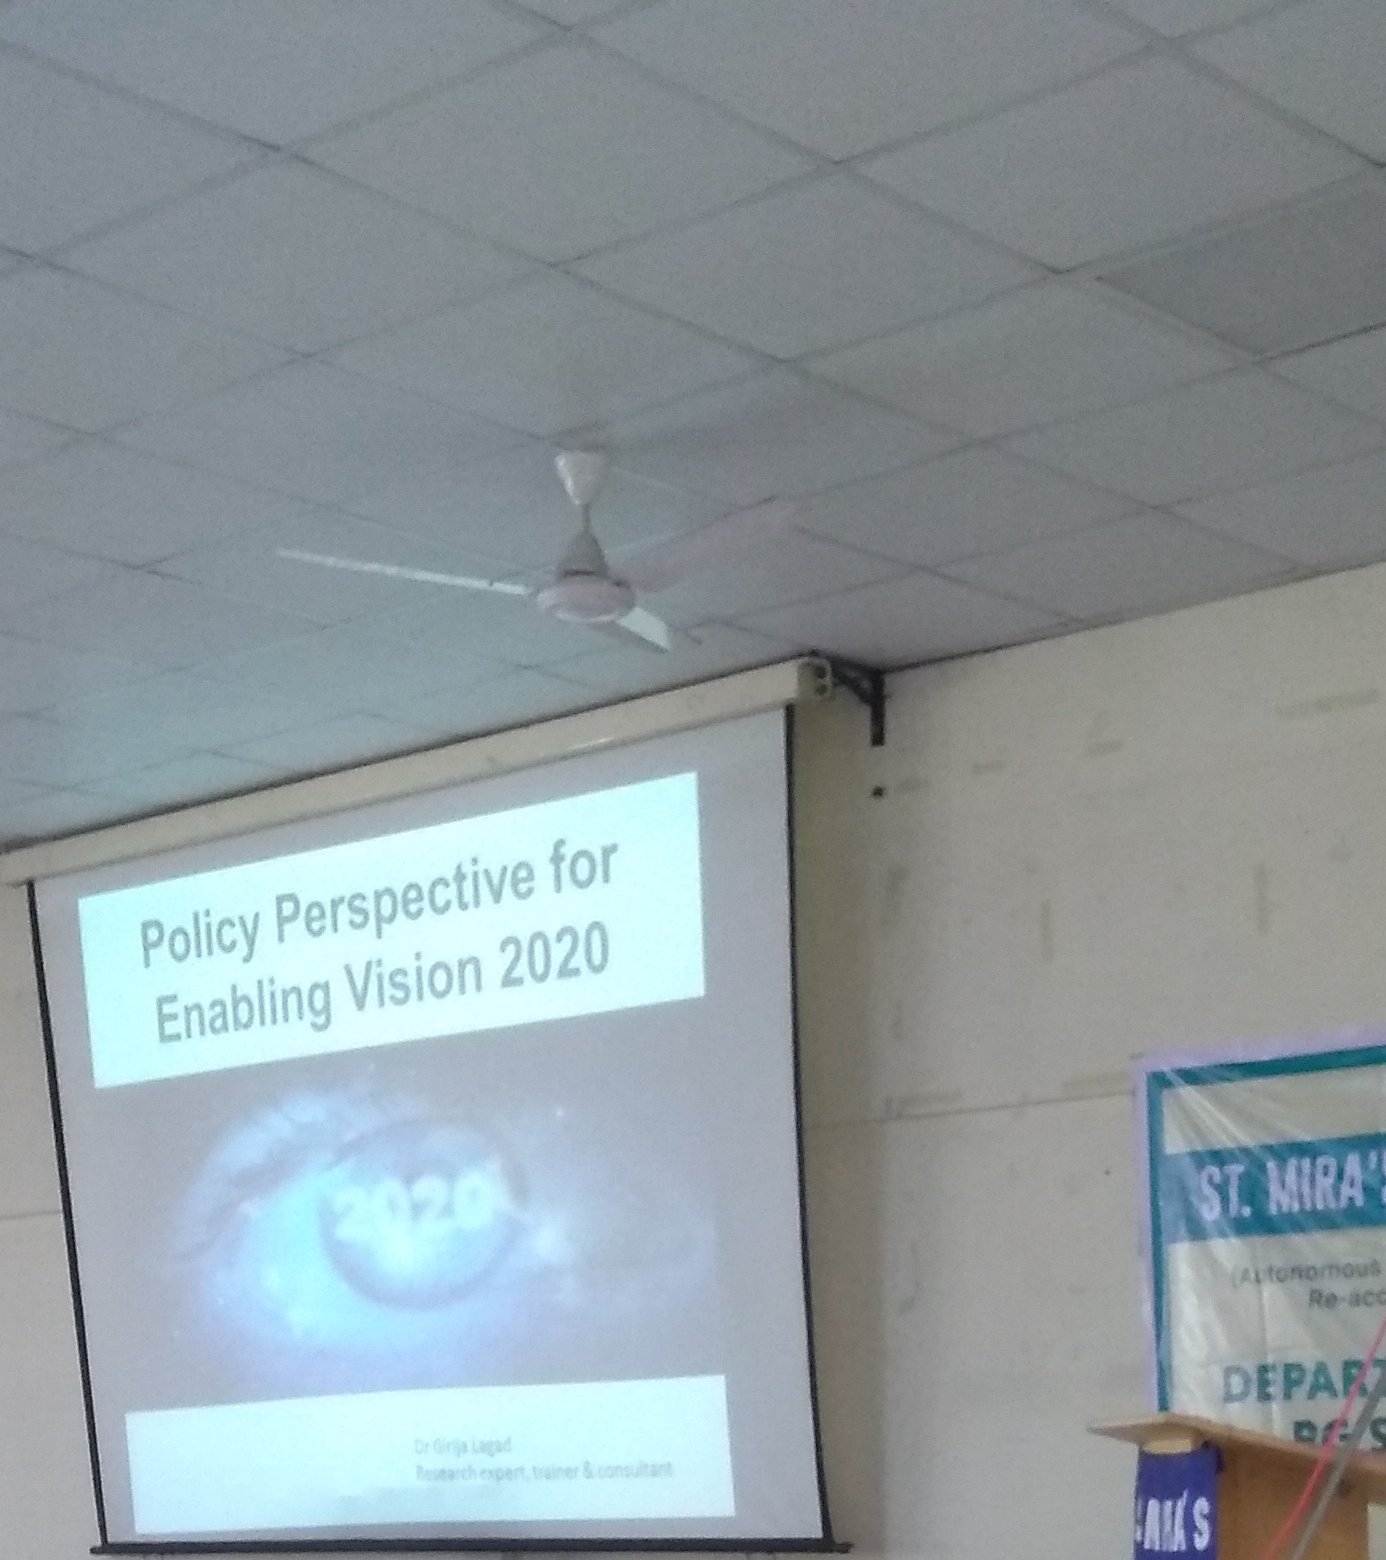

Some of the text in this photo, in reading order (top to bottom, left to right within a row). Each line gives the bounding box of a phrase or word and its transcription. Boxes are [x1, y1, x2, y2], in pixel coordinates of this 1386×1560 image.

[140, 838, 618, 968] Policy Perspective for
[155, 920, 611, 1044] Enabling Vision 2020
[332, 1174, 494, 1241] 2020
[1199, 1164, 1252, 1221] ST.
[416, 1464, 477, 1481] Research
[532, 1464, 580, 1479] trainer
[583, 1460, 595, 1479] &
[598, 1461, 673, 1479] consultant
